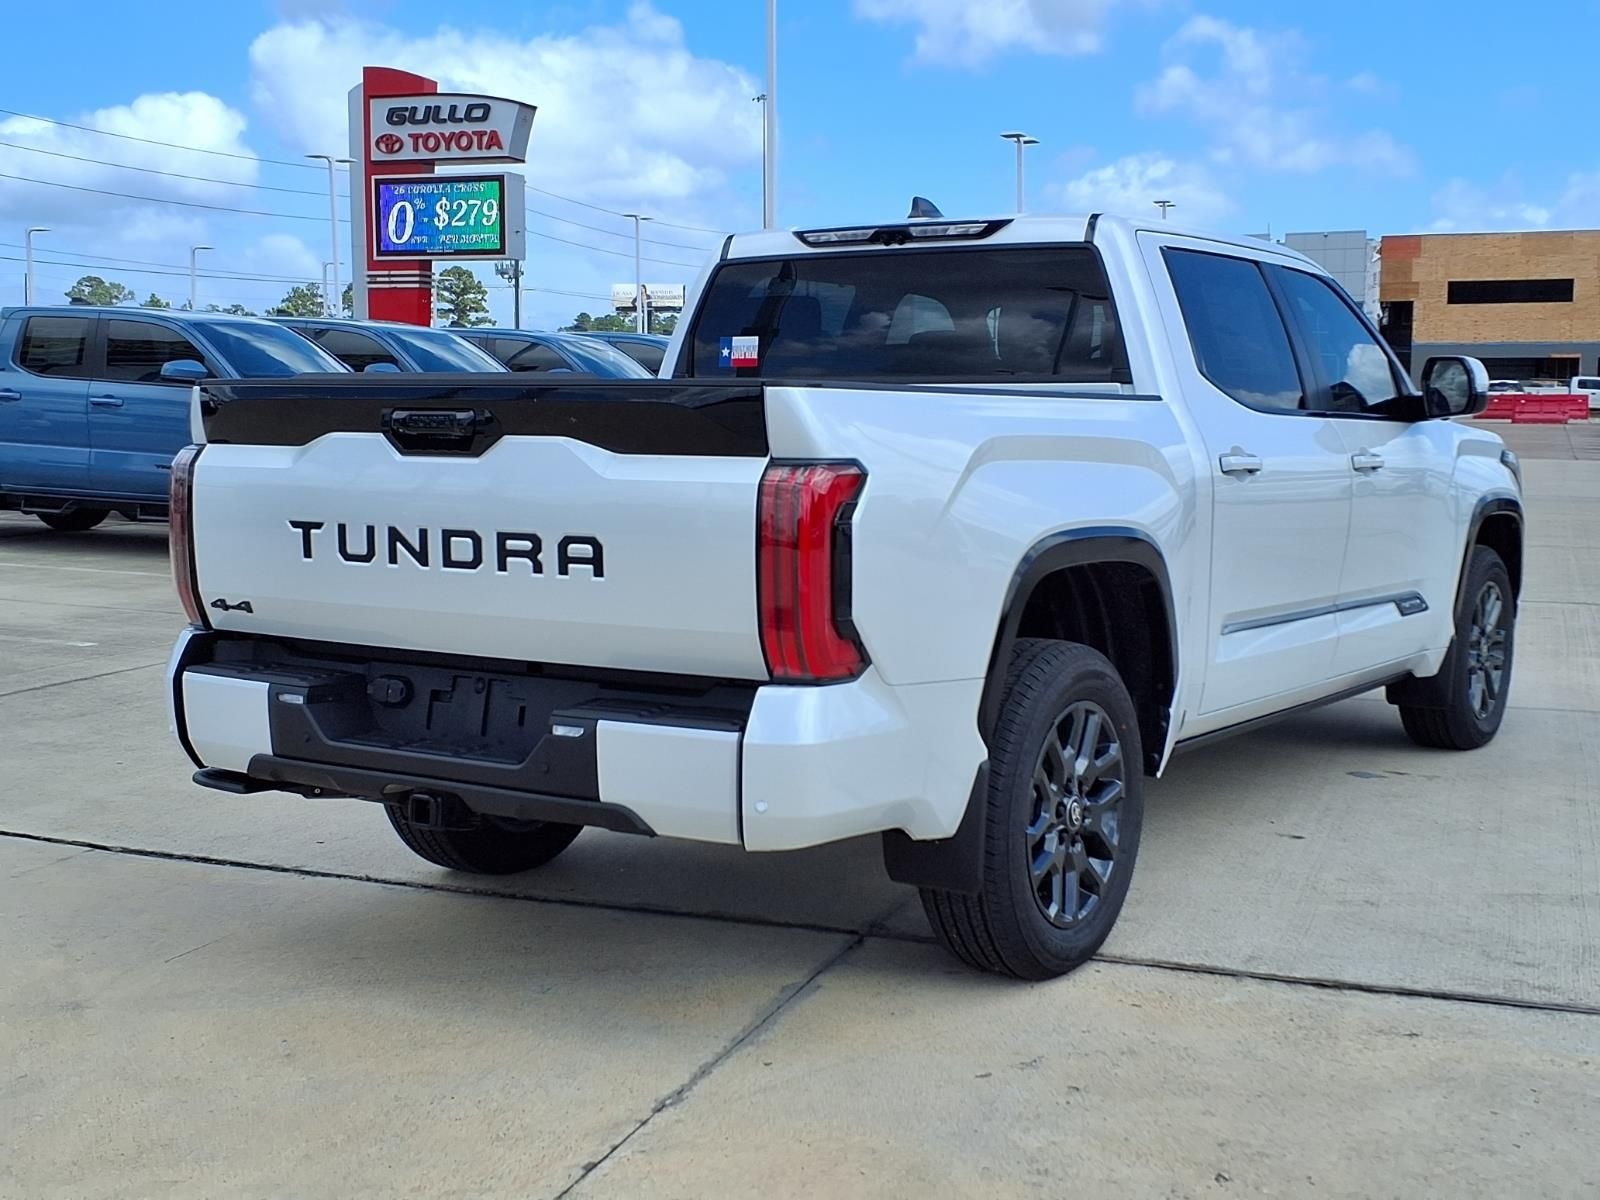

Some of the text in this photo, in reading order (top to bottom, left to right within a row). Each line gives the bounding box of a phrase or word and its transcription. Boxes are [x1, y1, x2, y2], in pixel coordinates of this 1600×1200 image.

[386, 103, 491, 126] GULLO
[408, 130, 503, 153] TOYOTA
[434, 197, 498, 230] $279
[288, 520, 605, 580] TUNDRA
